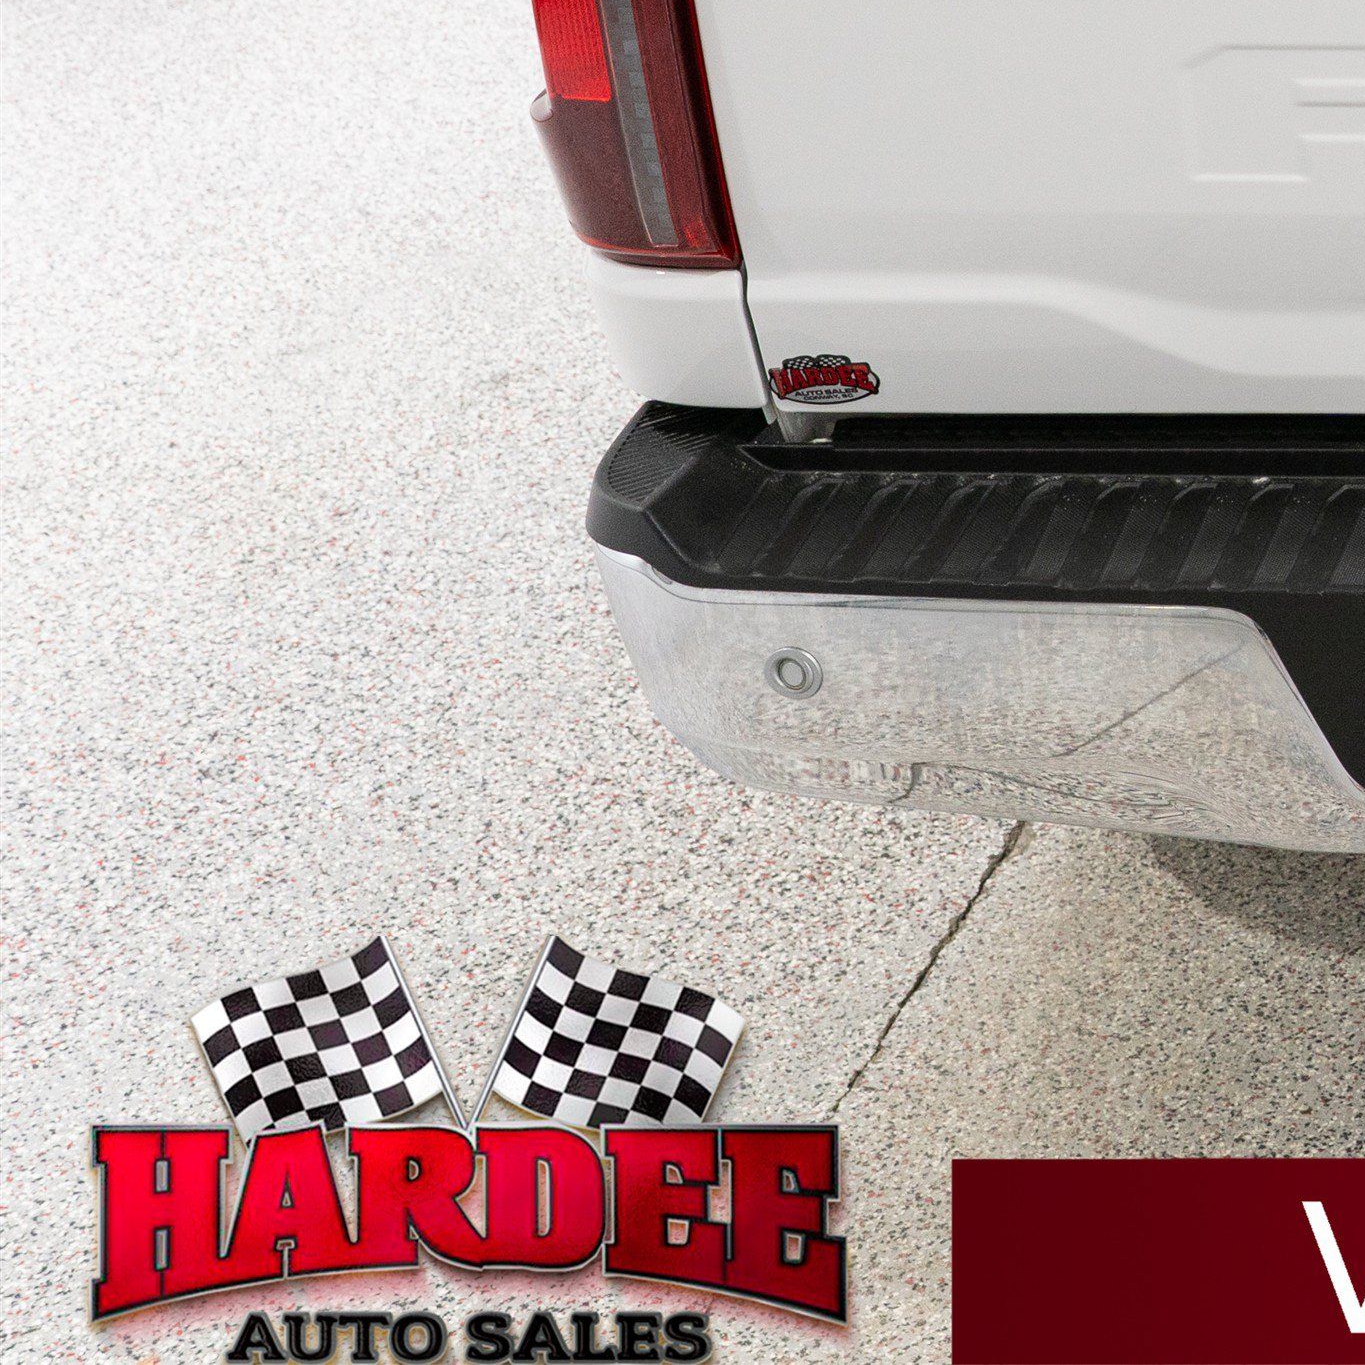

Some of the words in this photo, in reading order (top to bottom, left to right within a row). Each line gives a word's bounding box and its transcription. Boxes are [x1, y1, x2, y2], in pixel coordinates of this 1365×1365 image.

[769, 362, 879, 400] HARDEE
[795, 389, 822, 397] AUTO
[825, 387, 859, 395] SALES
